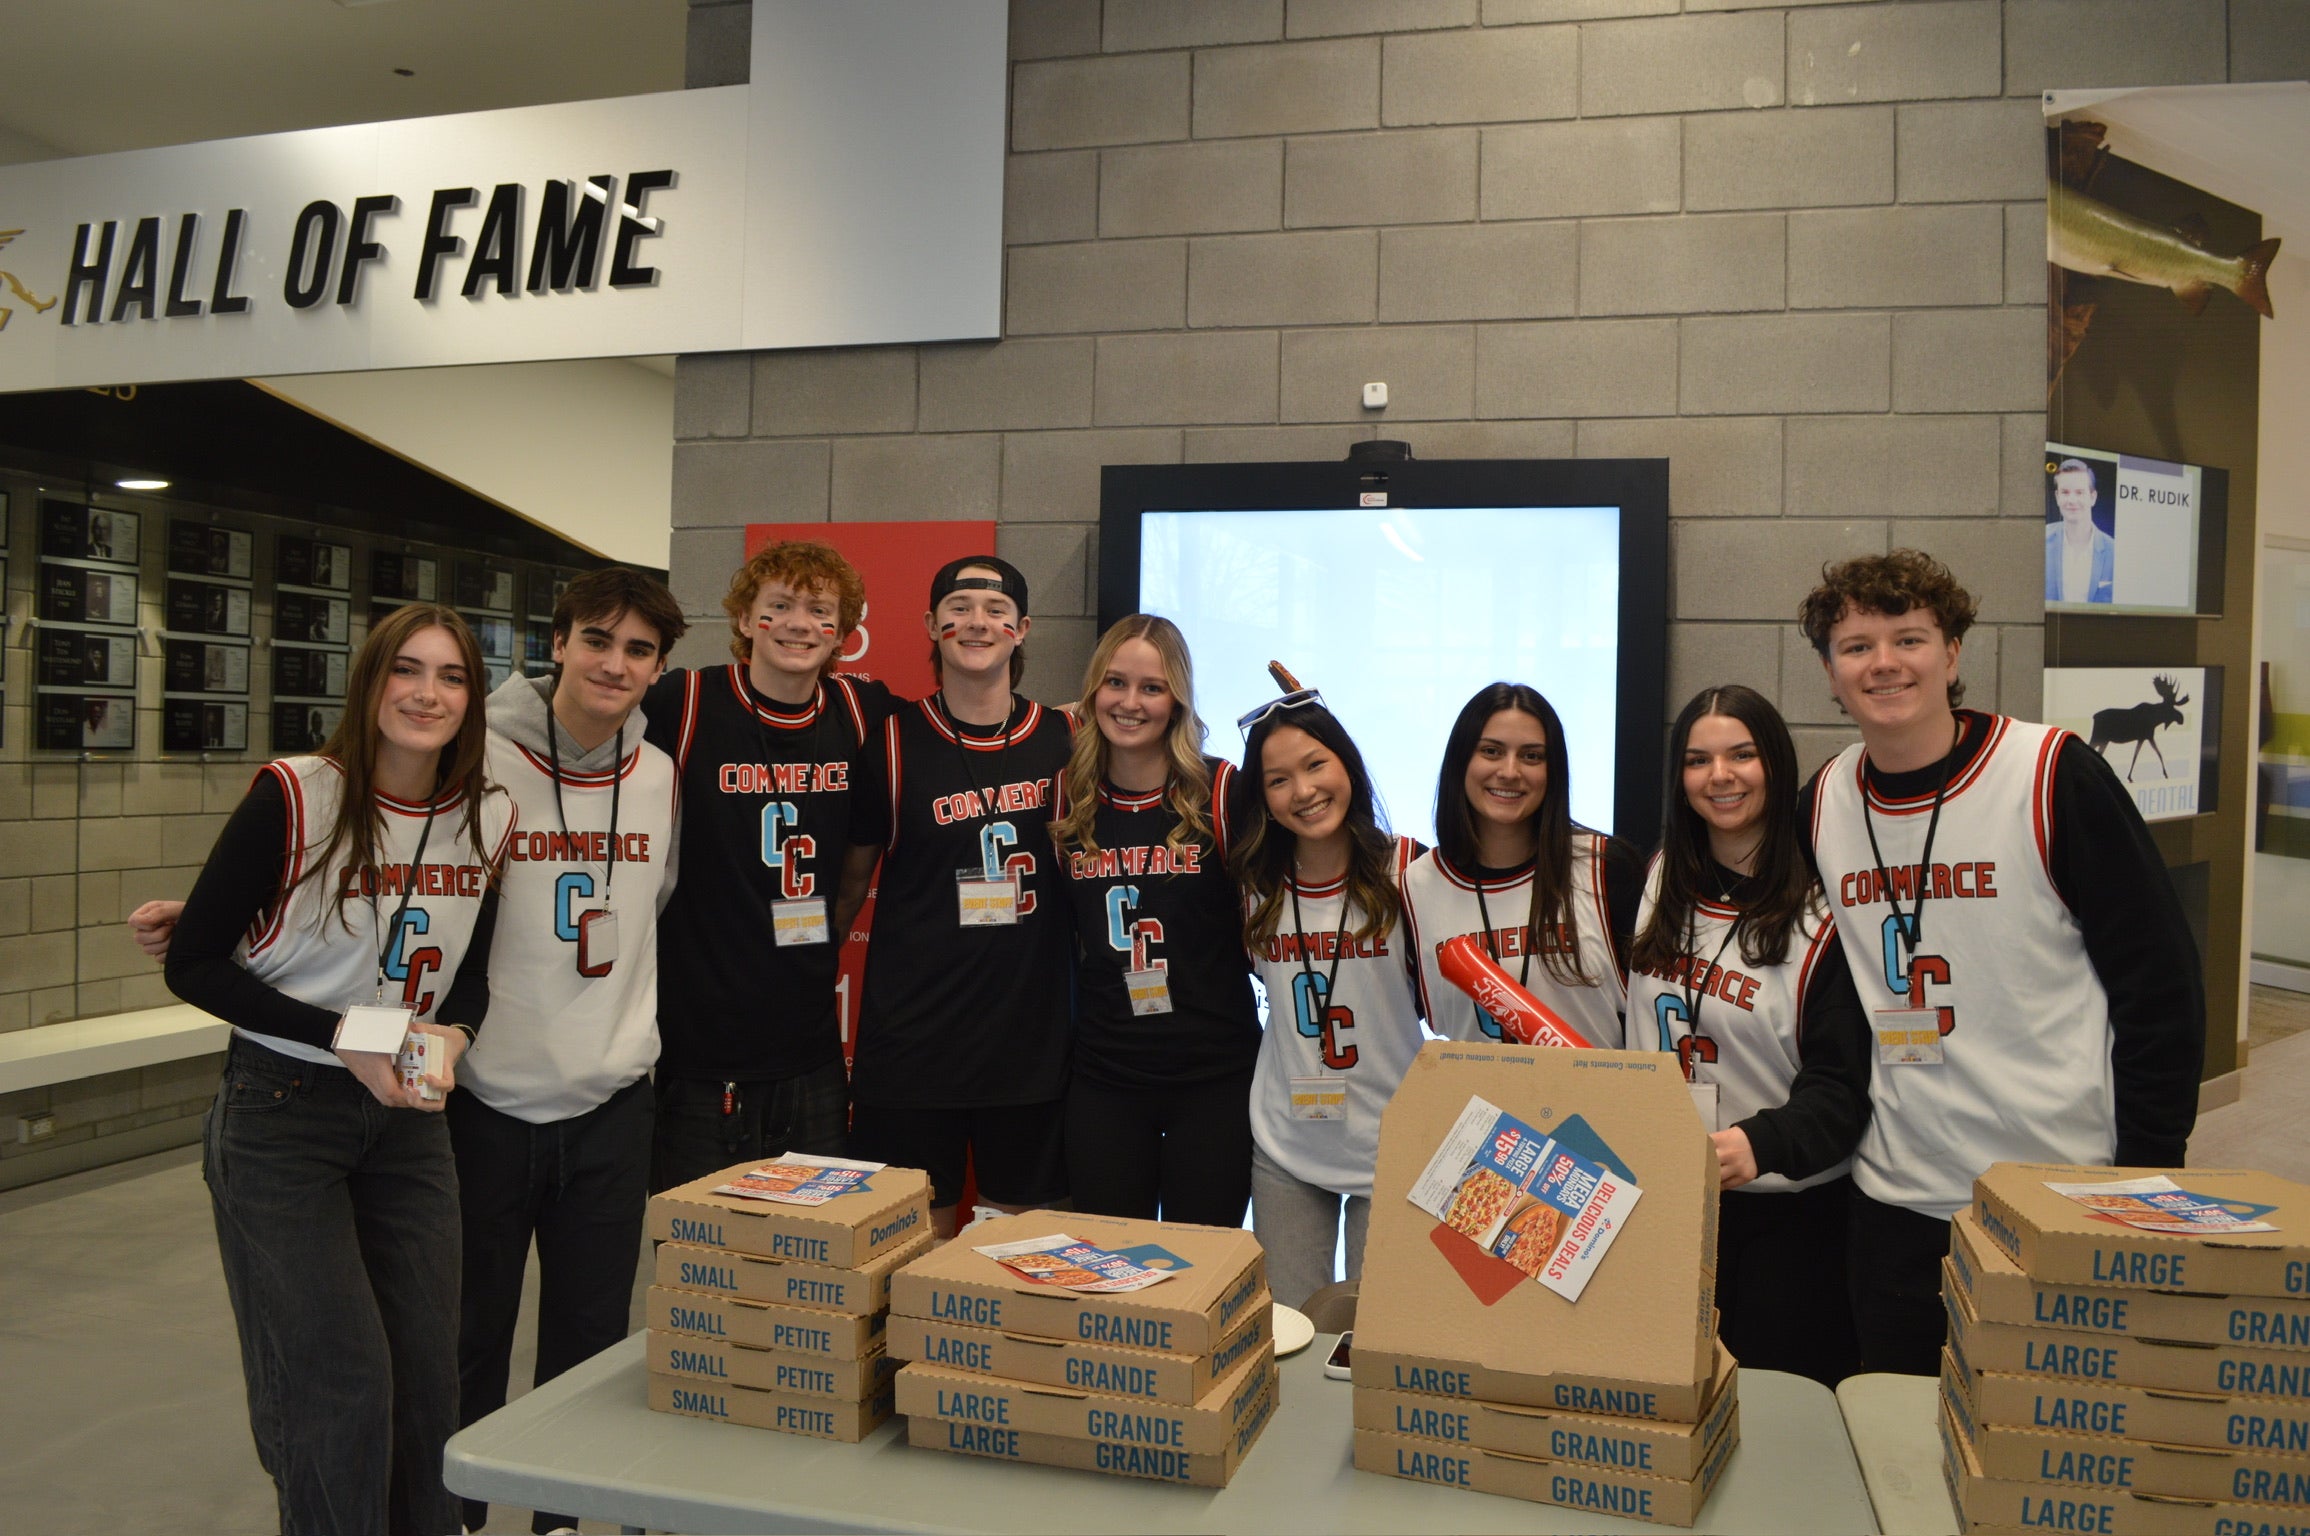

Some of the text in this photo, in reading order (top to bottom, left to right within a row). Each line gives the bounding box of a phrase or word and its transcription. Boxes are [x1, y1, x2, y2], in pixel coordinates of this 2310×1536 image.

[61, 169, 679, 325] HALL OF FAME
[2119, 484, 2189, 507] DR. RUDIK
[719, 761, 848, 794] COMMERCE
[2137, 785, 2195, 814] DENTAL
[509, 831, 650, 863] COMMERCE
[1070, 845, 1201, 880] COMMERCE
[1841, 862, 1997, 907] COMMERCE
[1264, 931, 1389, 963] OMMERCE
[1465, 1054, 1495, 1062] contenu
[1501, 1055, 1535, 1066] Attention
[1573, 1059, 1657, 1071] Caution: Contents Hot!
[1510, 1140, 1541, 1177] LARGE
[1548, 1155, 1574, 1187] 50%
[1556, 1166, 1583, 1203] MONDAYS
[1565, 1171, 1598, 1211] MEGA
[671, 1218, 829, 1262] SMALL PETITE
[870, 1208, 917, 1246] Domino's
[1547, 1181, 1617, 1280] DELICIOUS DEALS
[1580, 1227, 1605, 1261] Domino's
[681, 1263, 845, 1306] SMALL PETITE
[2093, 1250, 2186, 1286] LARGE
[1220, 1271, 1256, 1328] Domino's
[2035, 1292, 2129, 1331] LARGE
[670, 1307, 831, 1352] SMALL PETITE
[932, 1291, 1172, 1350] LARGE GRANDE
[925, 1334, 992, 1370] LARGE
[1065, 1357, 1157, 1397] GRANDE
[1212, 1321, 1260, 1379] Domino's
[2025, 1342, 2118, 1380] LARGE
[670, 1350, 835, 1393] SMALL PETITE
[1394, 1365, 1657, 1416] LARGE GRANDE
[672, 1390, 834, 1434] SMALL PETITE
[1233, 1363, 1267, 1424] Domino's
[937, 1389, 1184, 1447] LARGE GRANDE
[1237, 1394, 1271, 1456] Domino's
[2033, 1396, 2127, 1435] LARGE
[949, 1423, 1190, 1480] LARGE GRANDE
[1396, 1405, 1652, 1470] LARGE GRANDE
[1397, 1449, 1652, 1517] LARGE GRANDE
[2040, 1450, 2134, 1487] LARGE
[2021, 1497, 2114, 1535] LARGE
